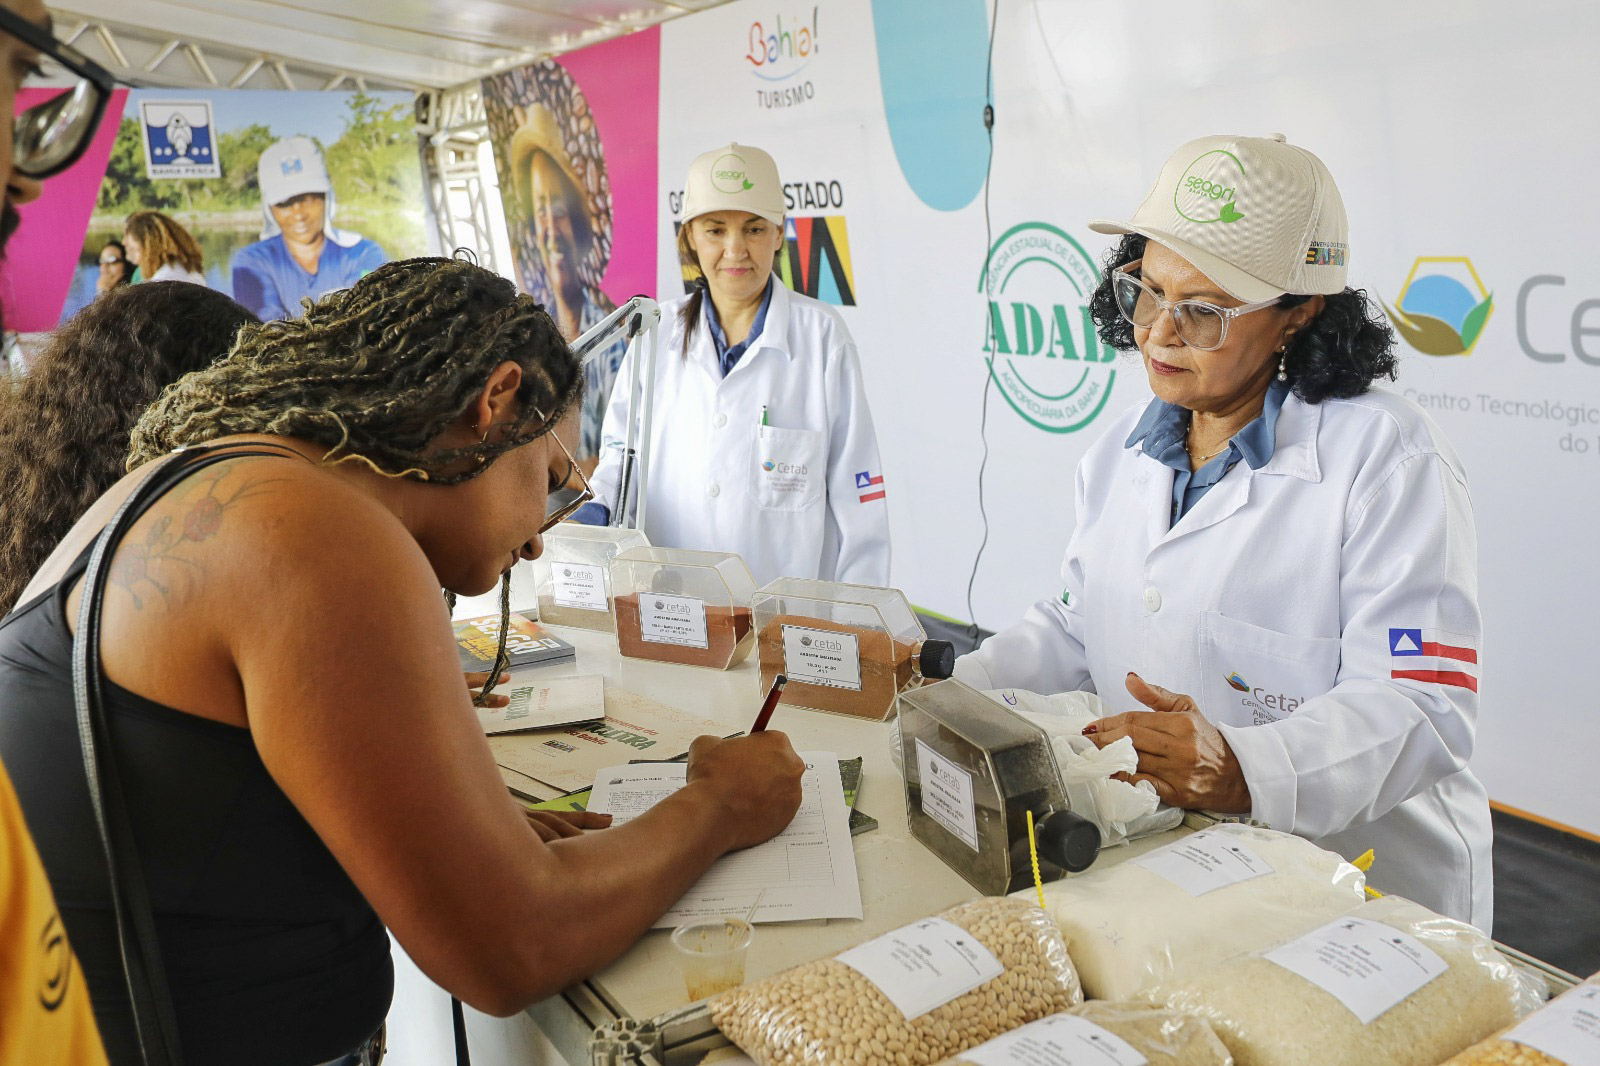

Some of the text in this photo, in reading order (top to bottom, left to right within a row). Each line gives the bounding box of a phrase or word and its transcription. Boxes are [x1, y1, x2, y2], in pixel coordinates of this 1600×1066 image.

[745, 6, 818, 67] Bahia!
[757, 80, 814, 109] TURISMO
[715, 169, 746, 180] seagri
[783, 180, 843, 211] STADO
[1184, 175, 1236, 201] seagri
[1009, 236, 1053, 256] ESTADUAL
[1053, 243, 1070, 260] DE
[1065, 403, 1078, 419] DA
[1559, 431, 1590, 454] do
[777, 462, 808, 475] Cetab
[666, 602, 691, 614] cetab
[814, 639, 842, 651] cetab
[1253, 687, 1304, 713] Ceta
[938, 768, 961, 791] cetab
